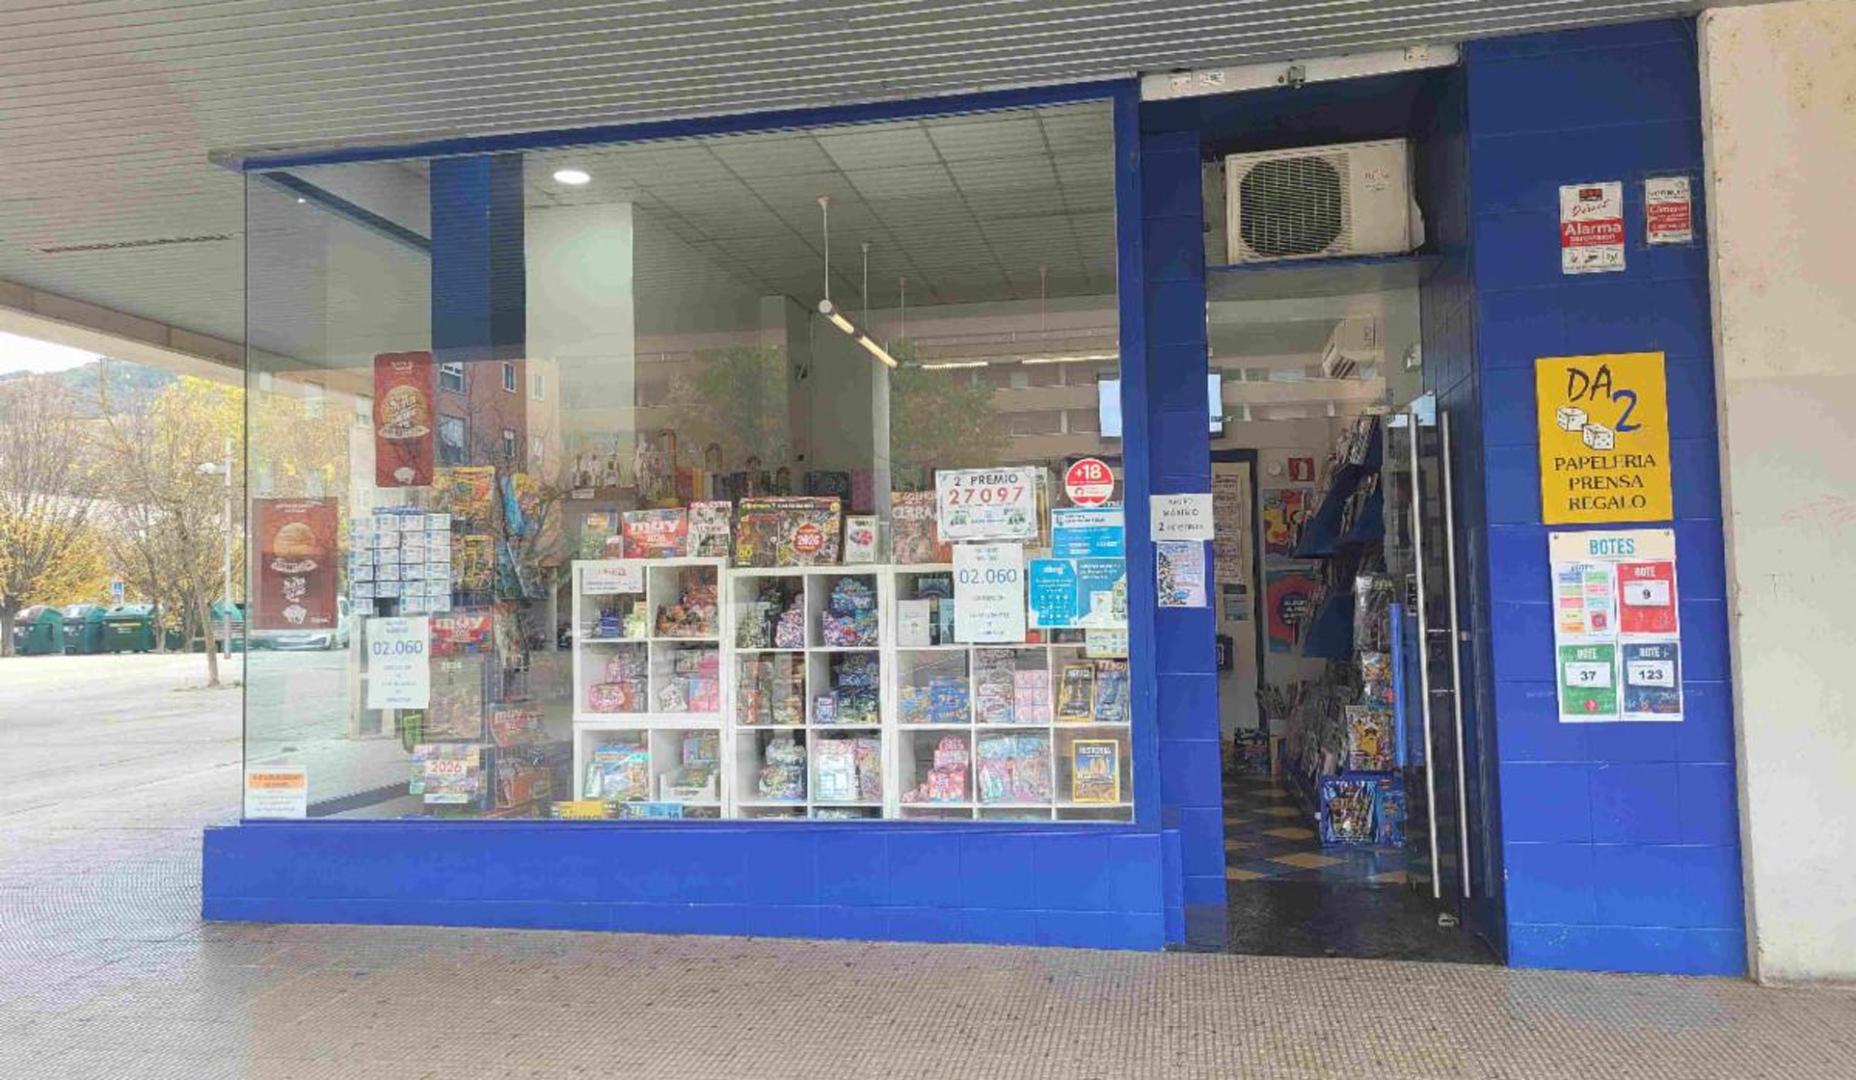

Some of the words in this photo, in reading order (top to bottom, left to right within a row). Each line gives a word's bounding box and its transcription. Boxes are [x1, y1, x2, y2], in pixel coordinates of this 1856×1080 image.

[1565, 223, 1622, 236] Alarma
[1567, 364, 1612, 402] DA
[1612, 389, 1643, 432] 2
[1554, 454, 1656, 471] PAPELERIA
[1076, 464, 1102, 479] +18
[954, 477, 961, 486] 2
[971, 474, 1018, 485] PREMIO
[1569, 475, 1644, 491] PRENSA
[949, 486, 1025, 505] 27097
[1569, 495, 1646, 511] REGALO
[1589, 538, 1636, 555] BOTES
[959, 568, 1017, 584] 02.060
[1642, 589, 1651, 599] 9
[373, 640, 423, 655] 02.060
[1580, 671, 1597, 681] 37
[1638, 670, 1663, 680] 123
[432, 761, 462, 773] 2026
